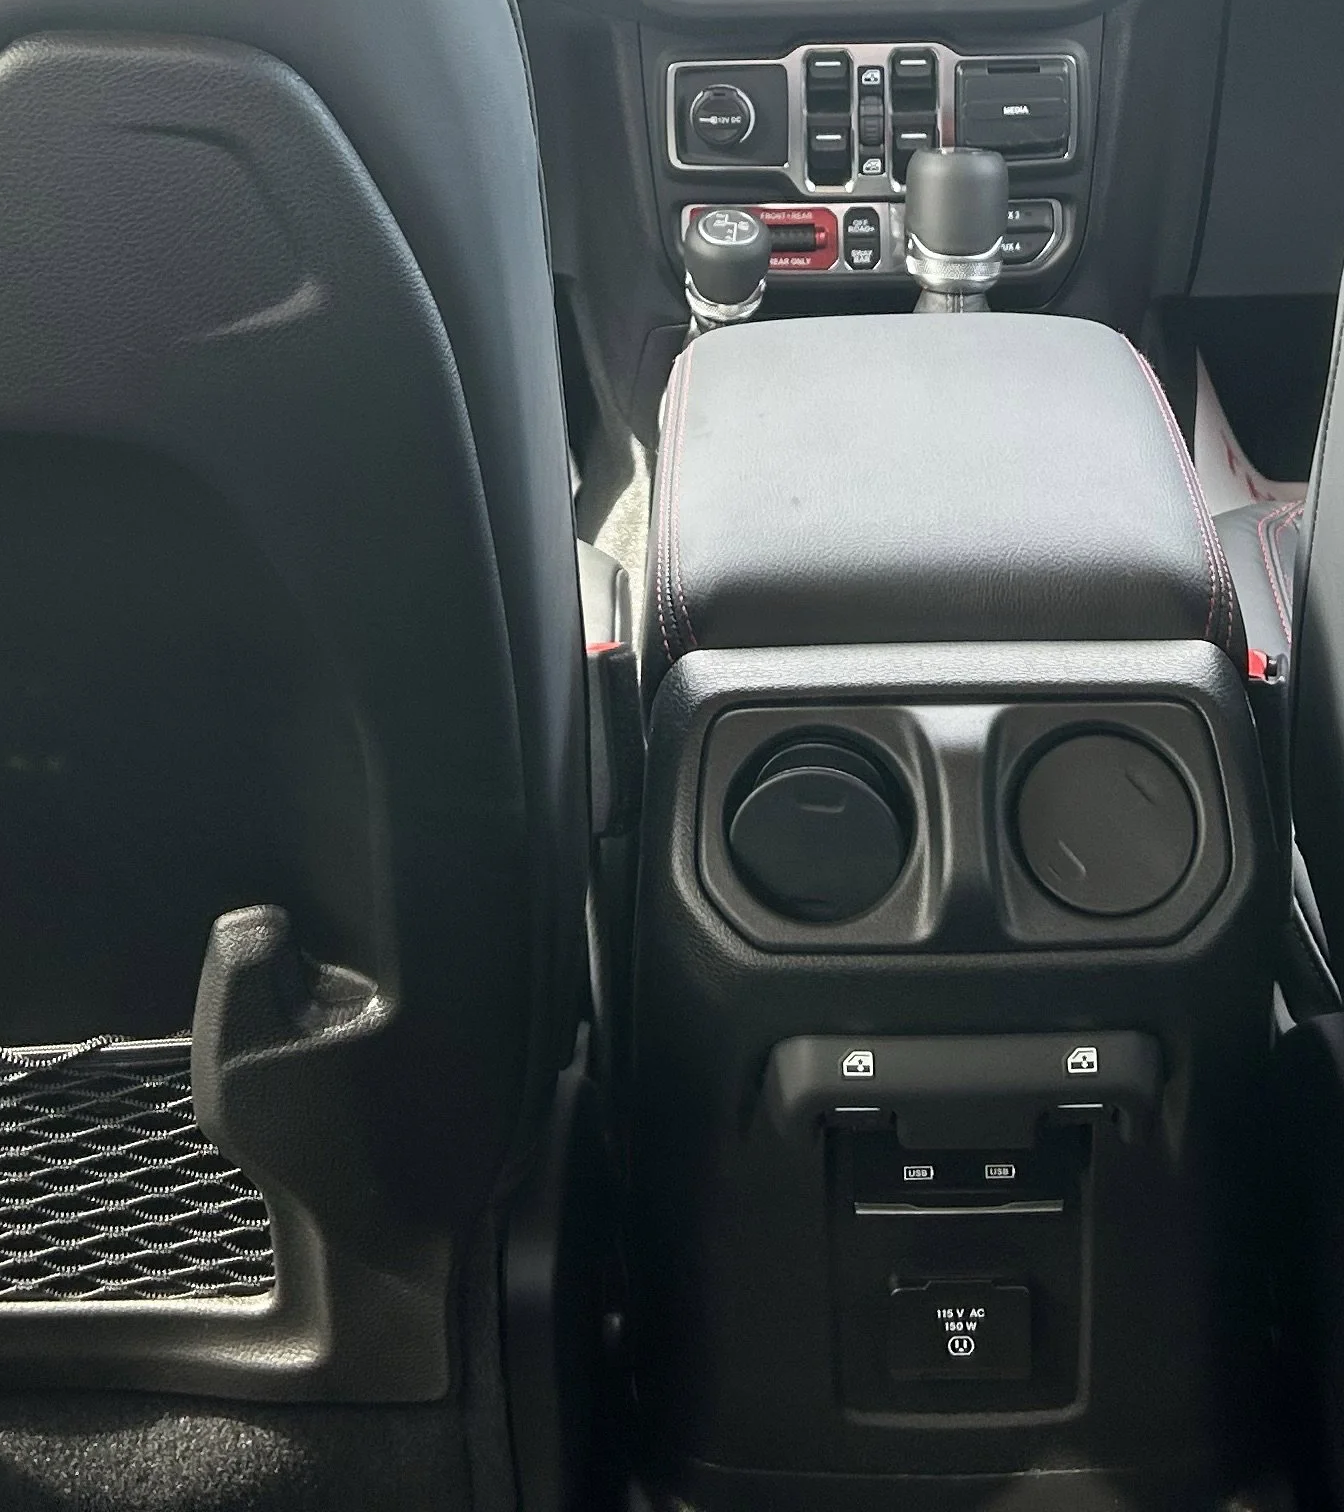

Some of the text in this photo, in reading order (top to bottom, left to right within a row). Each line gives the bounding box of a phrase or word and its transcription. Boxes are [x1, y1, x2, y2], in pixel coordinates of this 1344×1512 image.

[1003, 105, 1030, 115] MEDIA
[908, 1169, 928, 1177] USB
[989, 1167, 1009, 1176] USB
[936, 1308, 985, 1318] 115 V AC
[945, 1321, 977, 1331] 150 W
